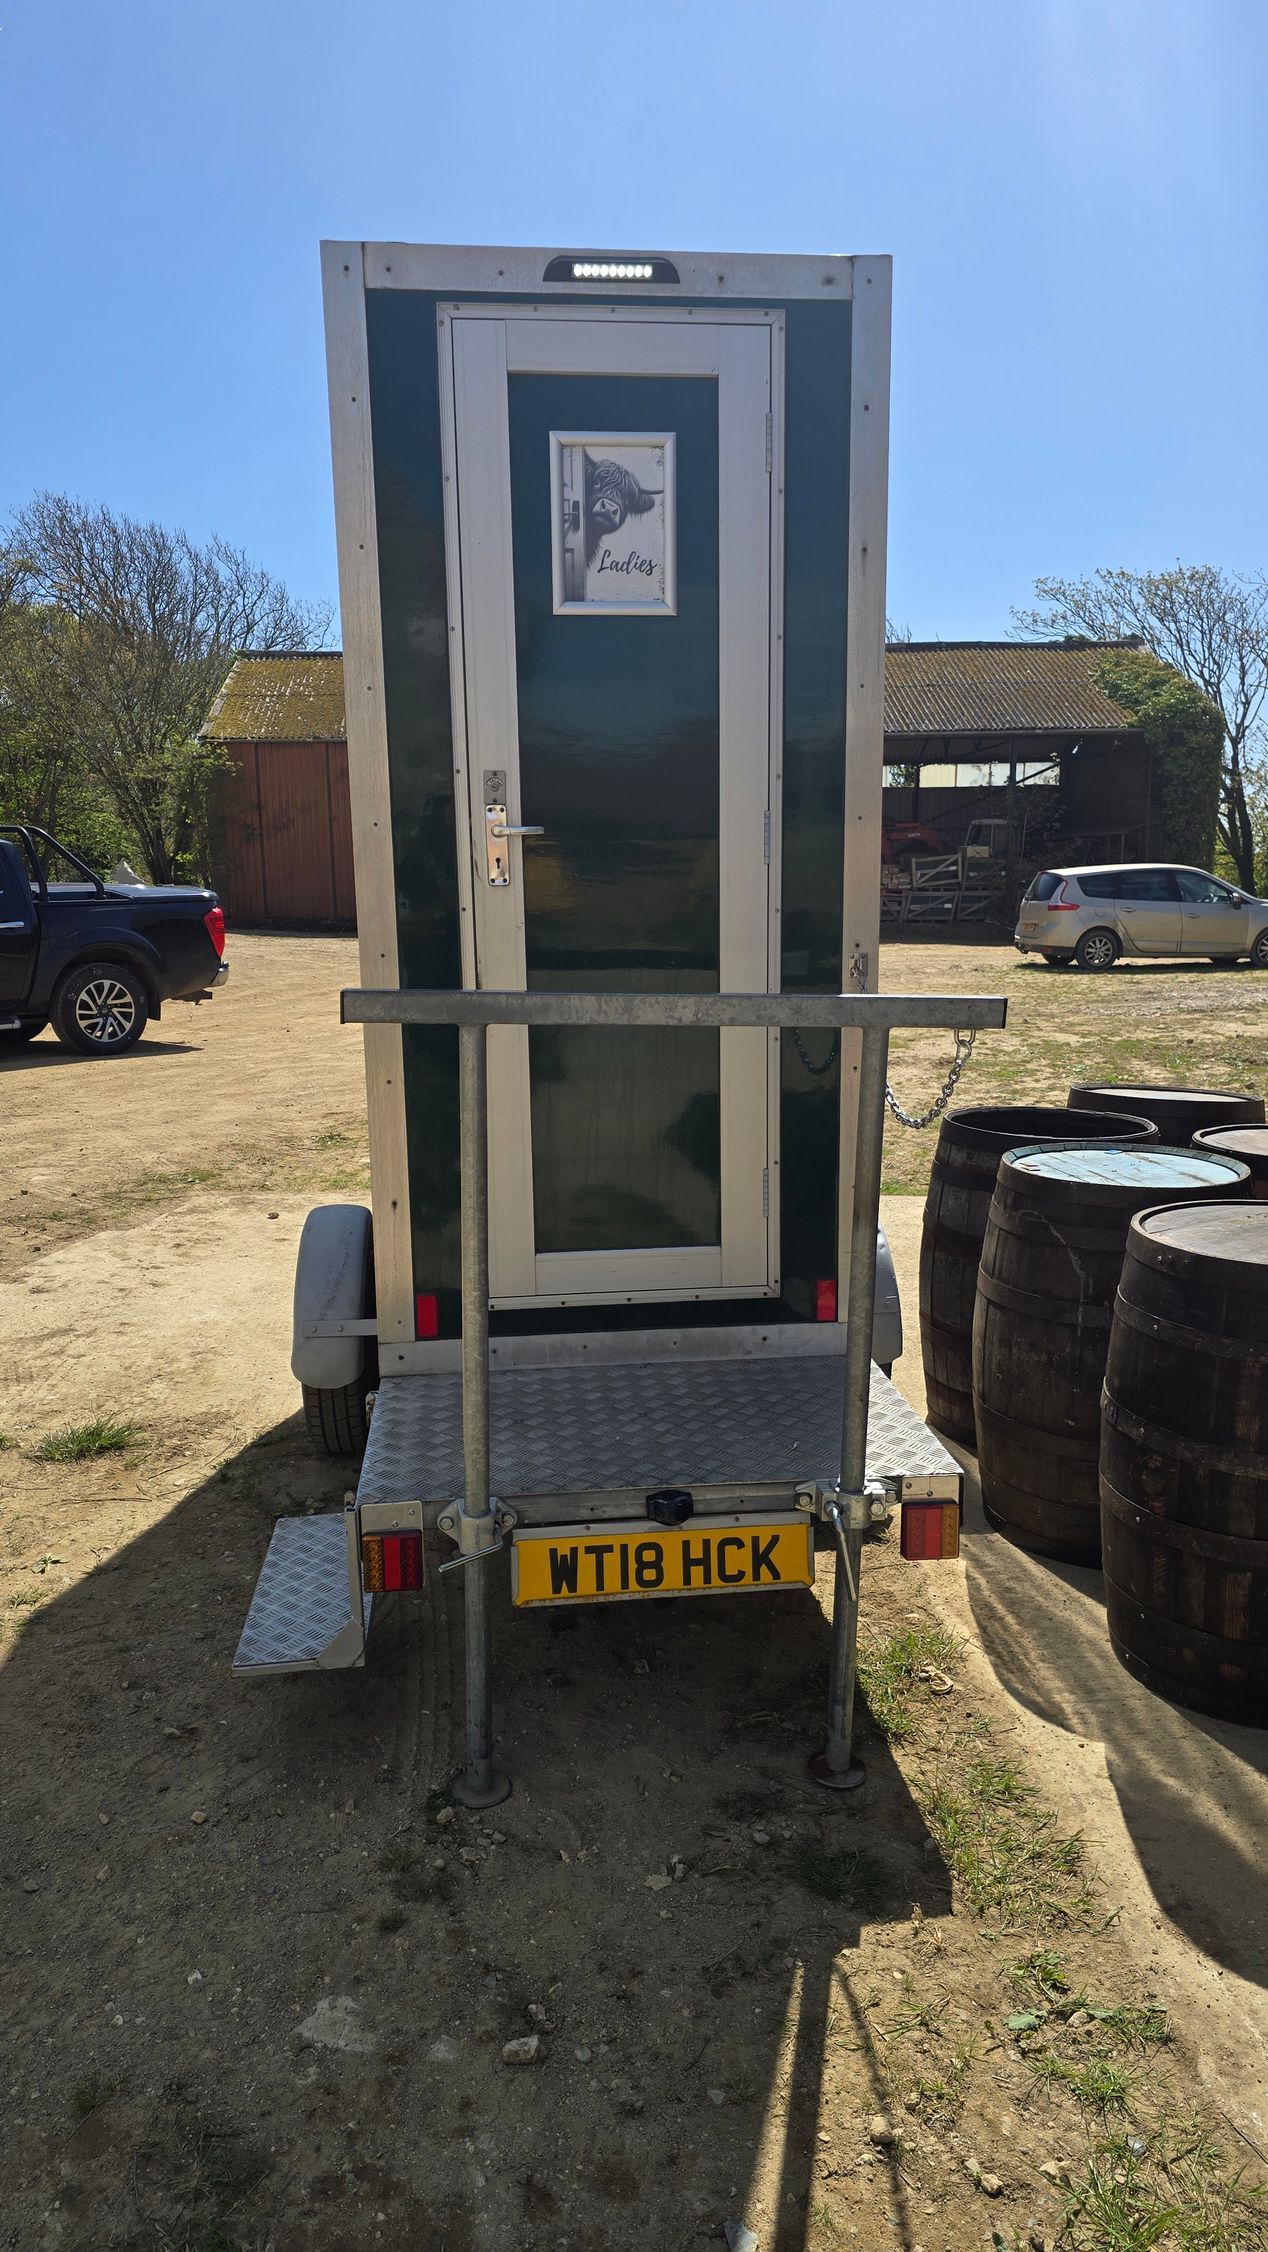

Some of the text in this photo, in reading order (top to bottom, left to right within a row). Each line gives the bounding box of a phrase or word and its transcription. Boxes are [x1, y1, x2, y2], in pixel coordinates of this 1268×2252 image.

[597, 549, 657, 576] Ladies
[549, 1534, 782, 1595] WT18 HCK
